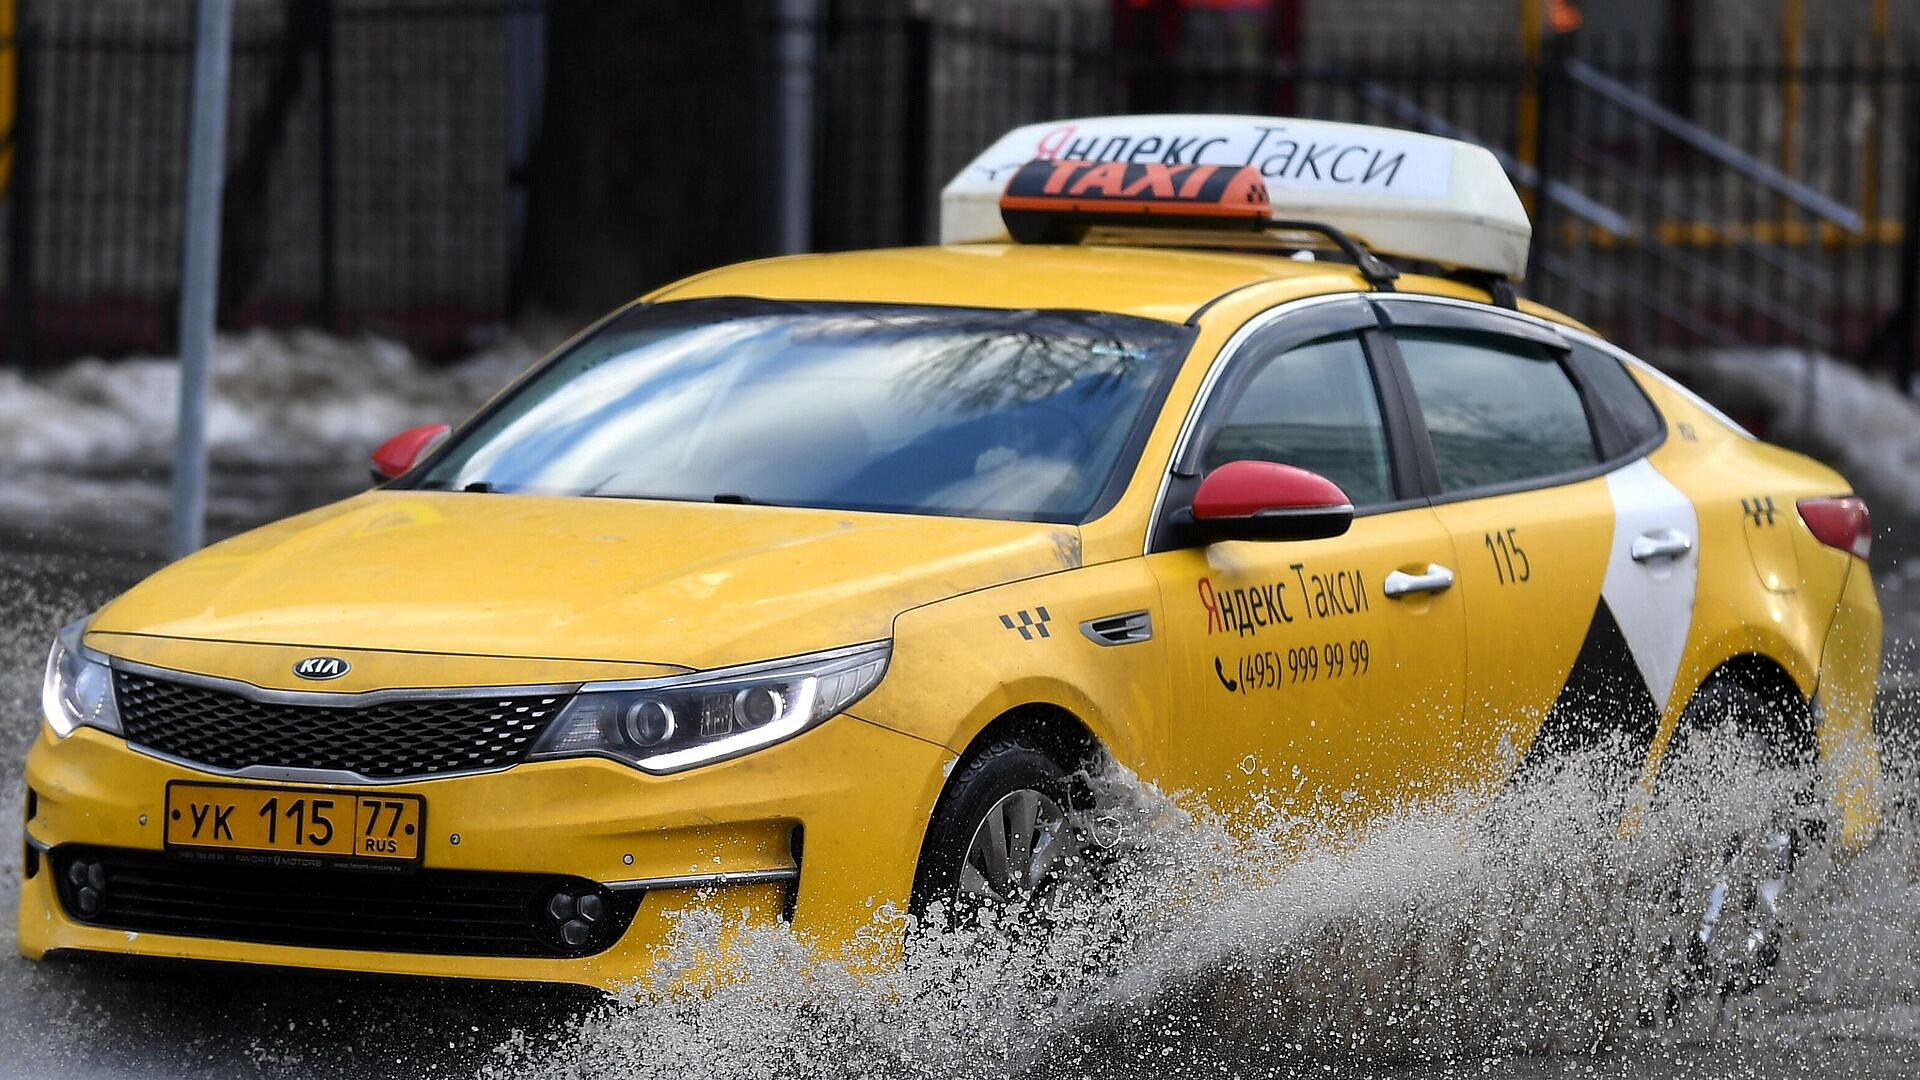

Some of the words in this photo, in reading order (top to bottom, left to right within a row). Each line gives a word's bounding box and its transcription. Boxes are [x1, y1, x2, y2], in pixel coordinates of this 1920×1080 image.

[1034, 126, 1228, 166] Яндекс
[1237, 126, 1407, 187] Такси
[1041, 160, 1218, 198] TAXI
[1485, 528, 1531, 585] 115
[1198, 577, 1294, 637] Яндекс
[1290, 563, 1369, 619] Такси
[300, 658, 340, 674] KIA
[1238, 651, 1282, 694] (495)
[1288, 643, 1319, 684] 999
[1324, 641, 1345, 677] 99
[1350, 639, 1370, 674] 99
[190, 804, 235, 840] УК
[259, 797, 335, 846] 115
[362, 800, 404, 838] 77
[366, 839, 398, 853] RUS
[280, 857, 323, 868] MOTORS
